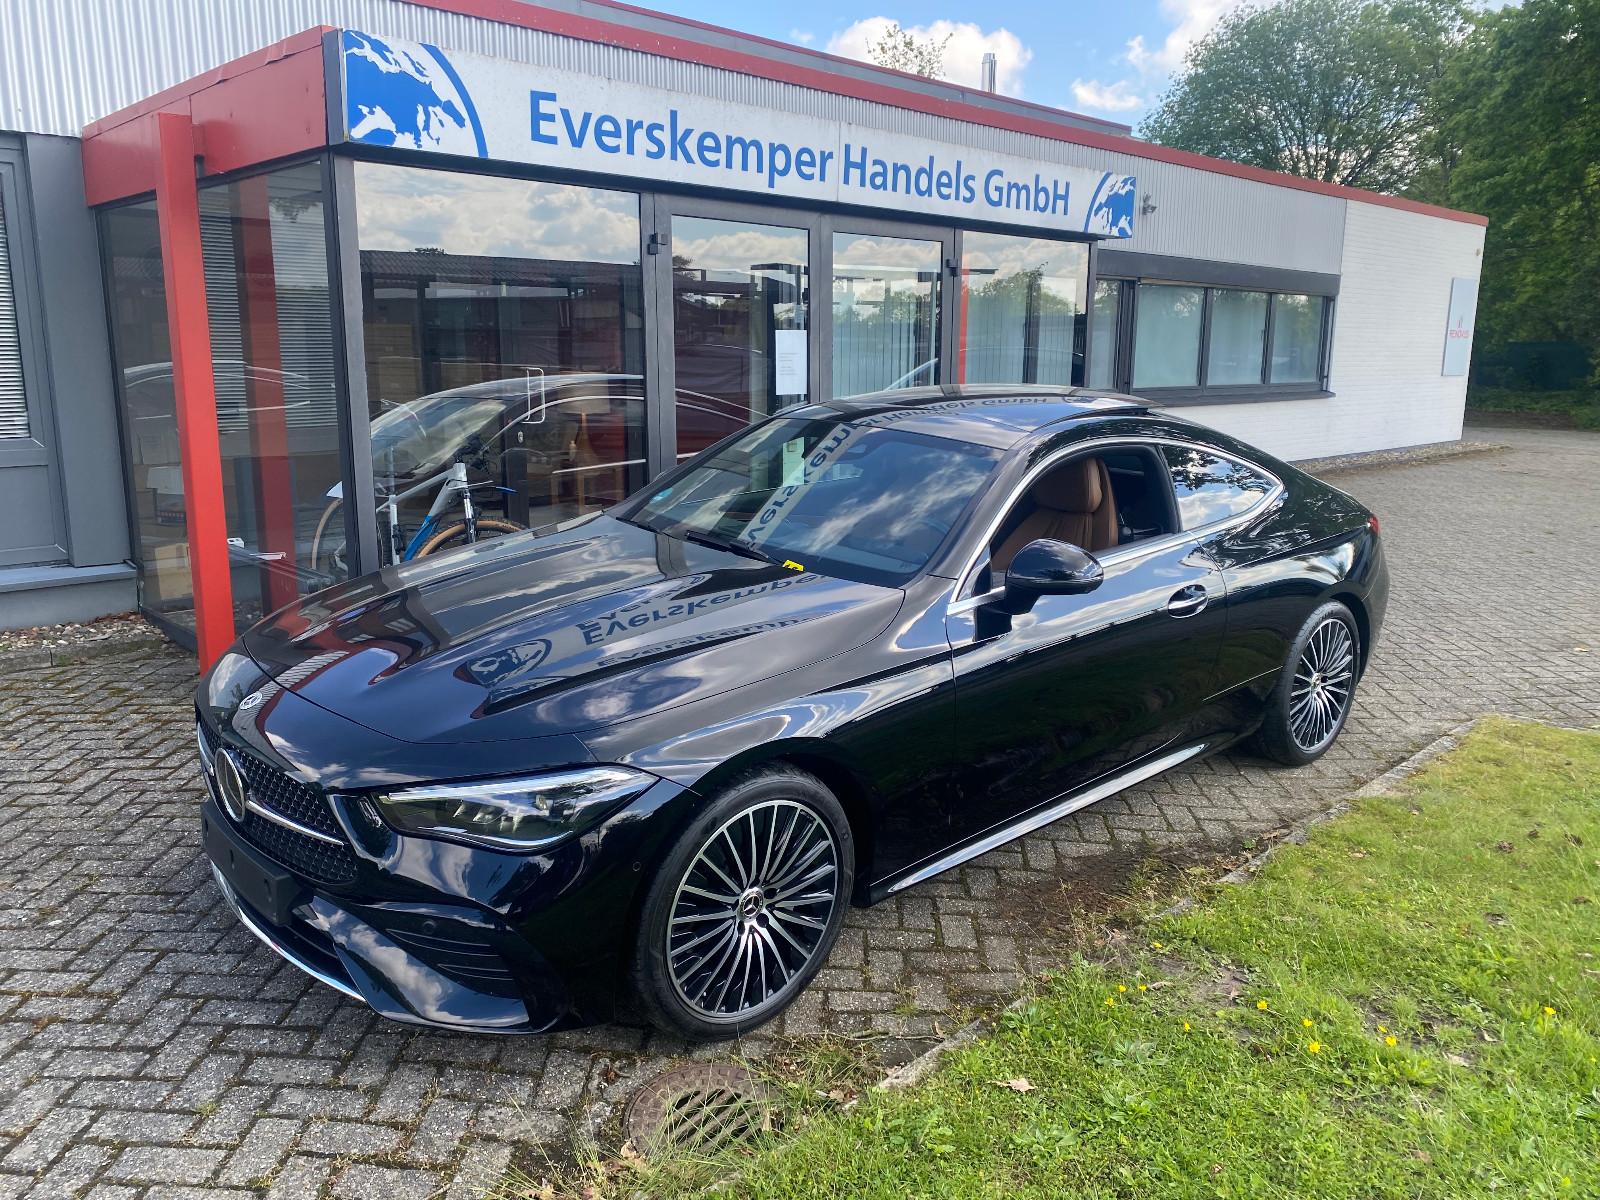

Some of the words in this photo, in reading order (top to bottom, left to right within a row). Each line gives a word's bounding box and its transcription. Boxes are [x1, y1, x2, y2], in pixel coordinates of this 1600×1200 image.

[528, 88, 834, 190] Everskemper
[842, 143, 977, 205] Handels
[983, 168, 1071, 217] GmbH
